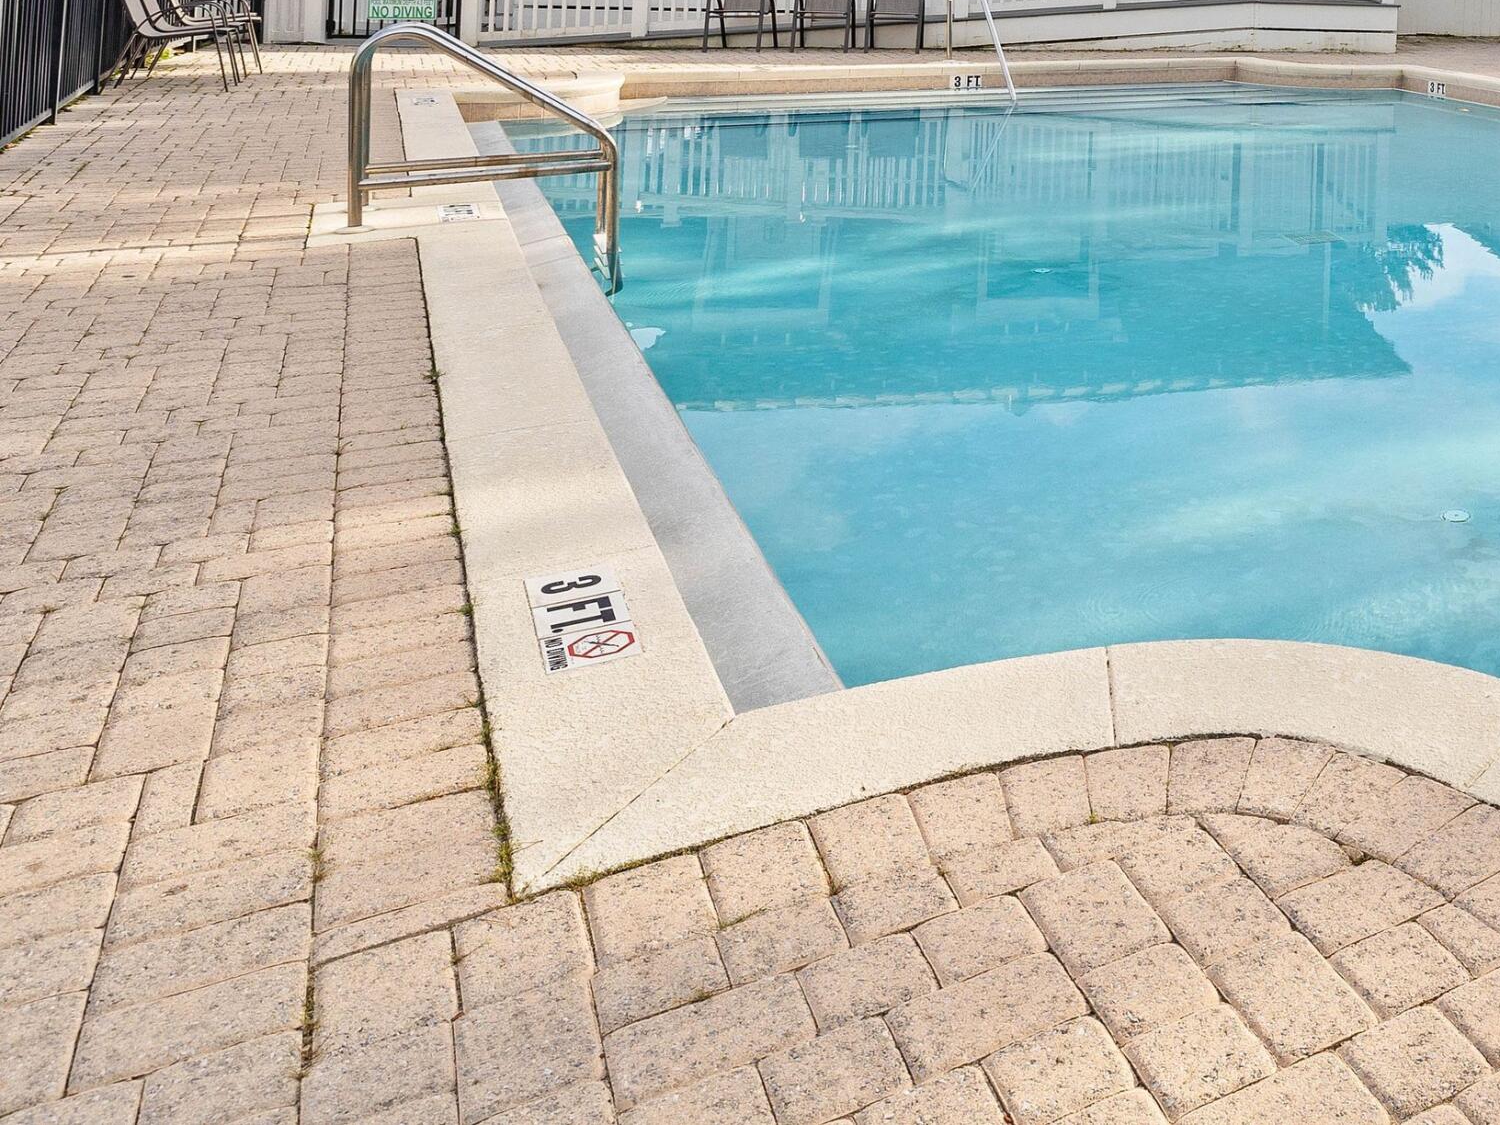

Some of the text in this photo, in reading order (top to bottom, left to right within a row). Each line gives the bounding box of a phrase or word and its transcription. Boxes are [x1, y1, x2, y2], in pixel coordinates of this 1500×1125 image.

[372, 6, 433, 18] NO DIVING
[954, 76, 961, 87] 3
[1430, 82, 1435, 93] 3
[540, 574, 602, 595] 3
[546, 595, 617, 634] FT.
[543, 637, 568, 671] NO DIVING
